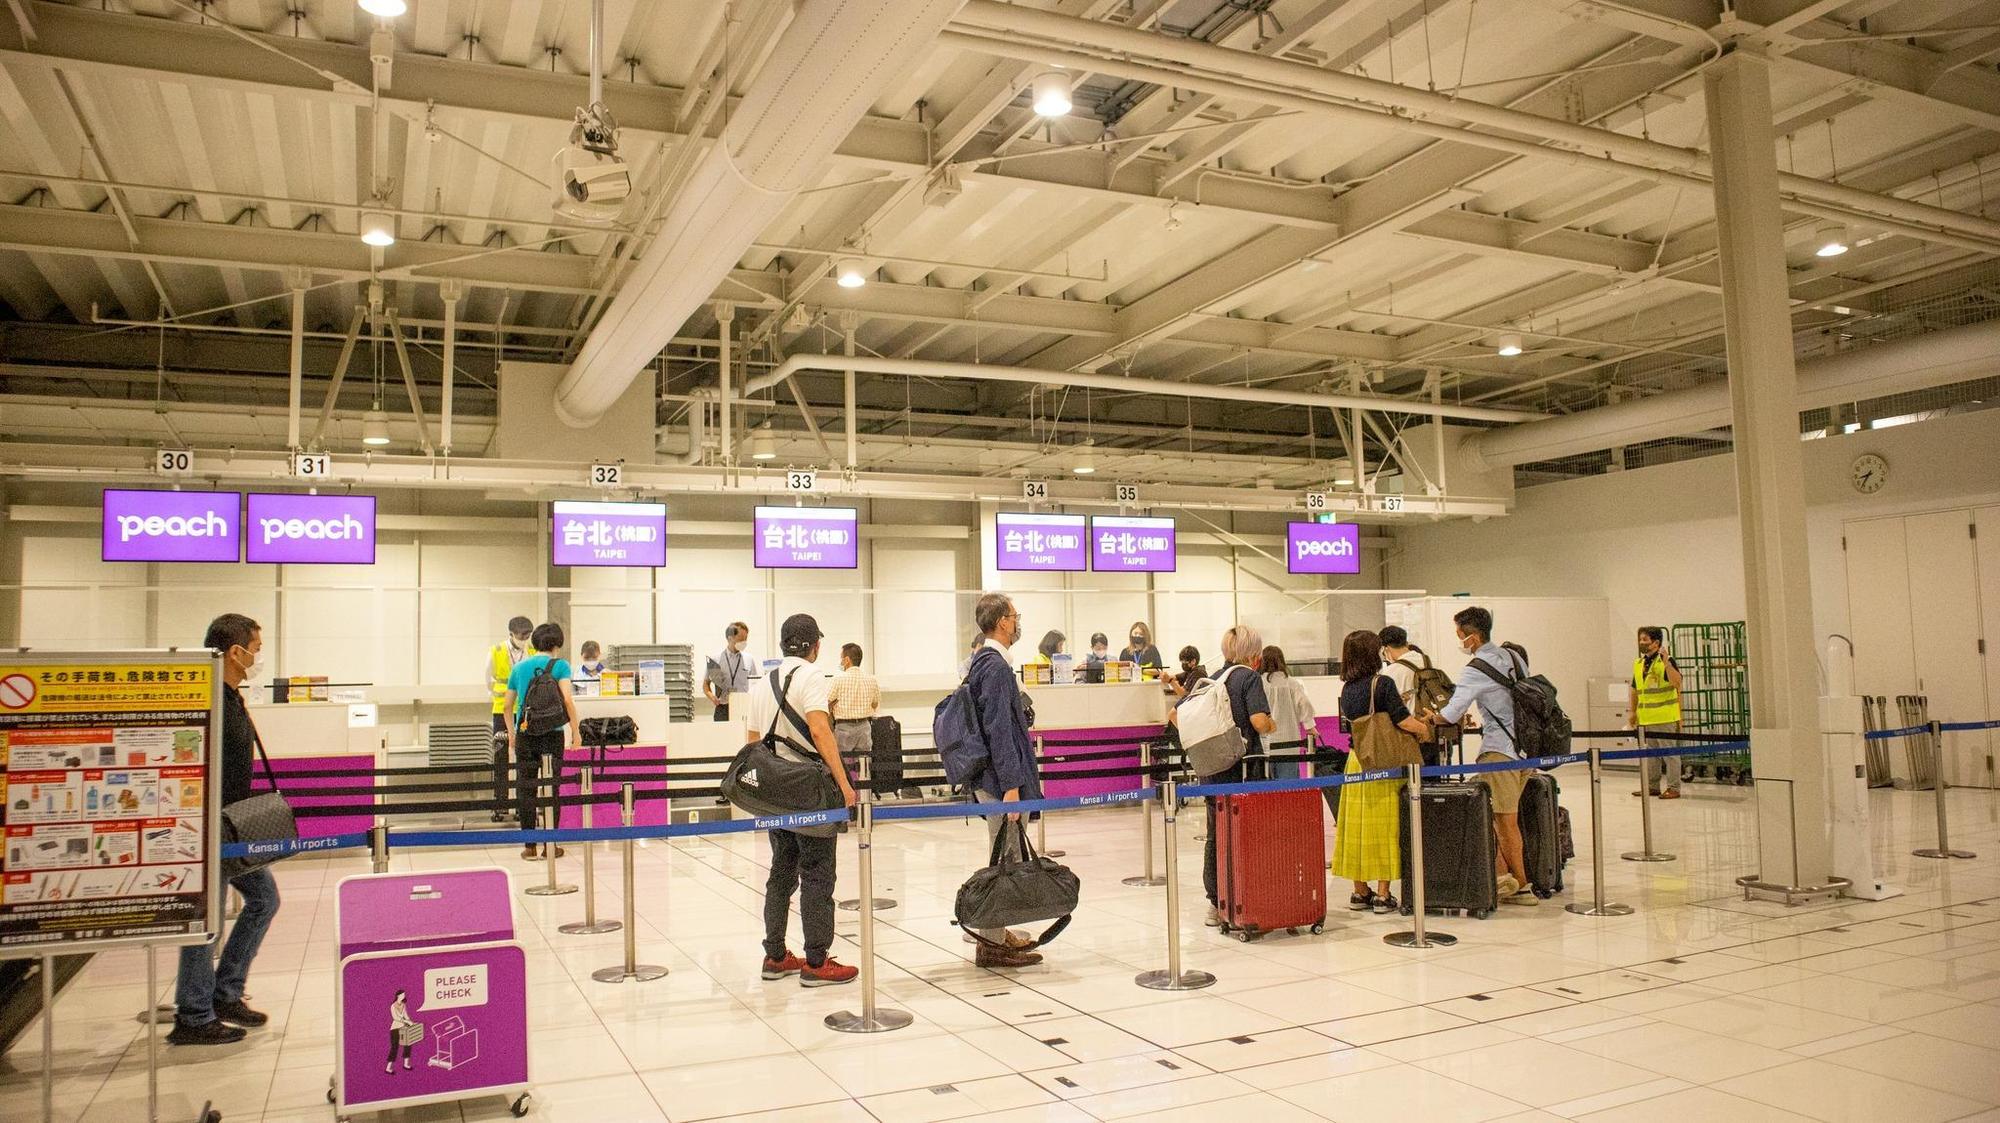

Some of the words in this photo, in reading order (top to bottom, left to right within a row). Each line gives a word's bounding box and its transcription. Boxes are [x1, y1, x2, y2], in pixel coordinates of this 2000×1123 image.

[161, 453, 189, 471] 30
[302, 457, 325, 475] 31
[595, 467, 618, 483] 32
[791, 473, 812, 489] 33
[1026, 483, 1045, 498] 34
[1119, 485, 1136, 501] 35
[1309, 494, 1324, 508] 36
[1388, 498, 1402, 511] 37
[117, 510, 228, 542] peach
[259, 513, 364, 545] peach
[593, 548, 627, 559] TAIPEI
[1295, 536, 1353, 560] peach
[791, 551, 823, 561] TAIPEI
[1029, 555, 1056, 564] TAIPEI
[1122, 556, 1147, 566] TAIPEI
[1080, 796, 1104, 805] Kansai
[1107, 792, 1138, 802] Airports
[755, 817, 783, 828] Kansai
[789, 813, 827, 824] Airports
[248, 840, 283, 854] Kansai
[290, 838, 338, 850] Airports
[435, 974, 477, 987] PLEASE
[435, 988, 472, 1000] CHECK
